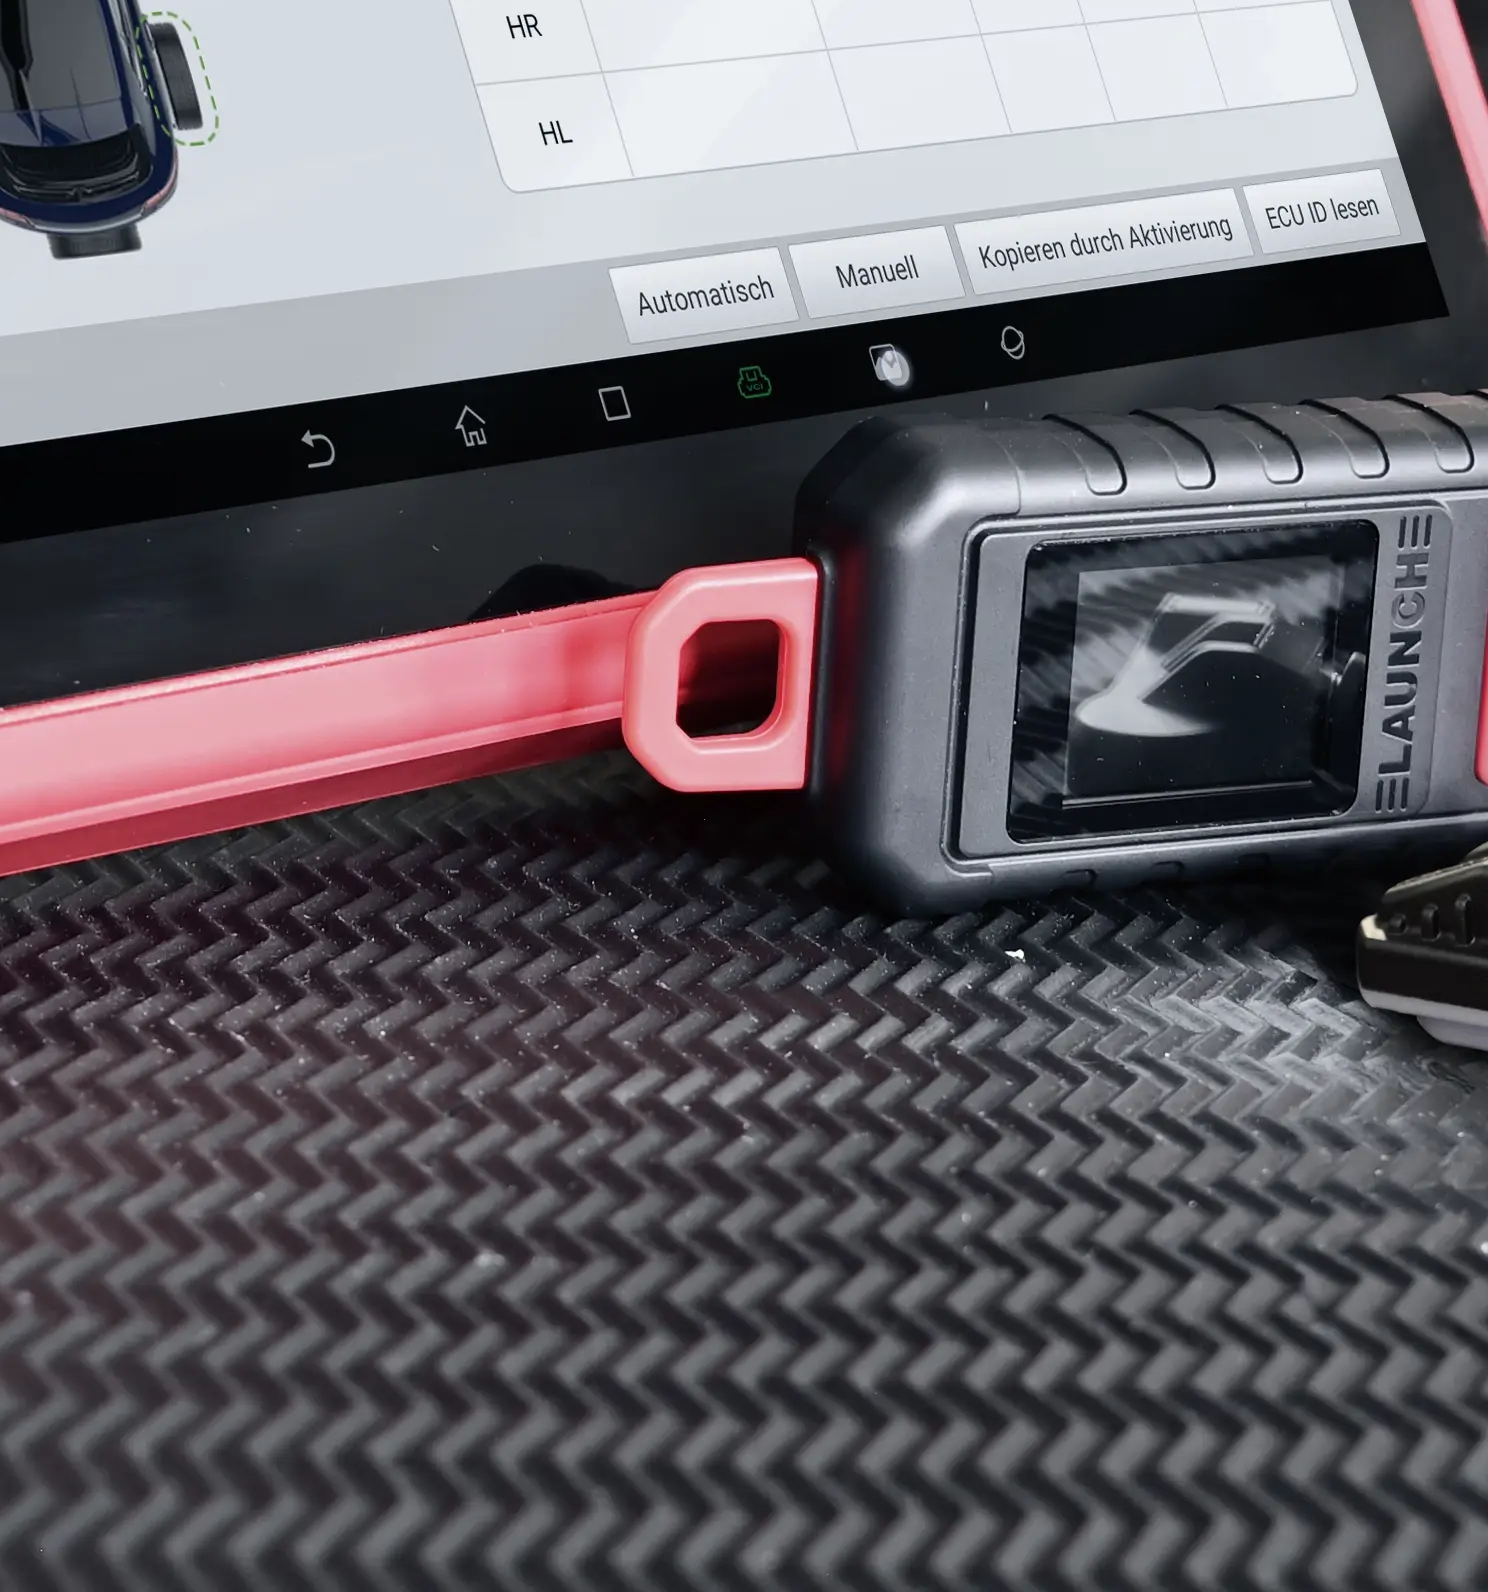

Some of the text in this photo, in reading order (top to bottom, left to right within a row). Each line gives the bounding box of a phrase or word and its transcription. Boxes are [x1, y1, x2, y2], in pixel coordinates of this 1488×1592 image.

[506, 14, 542, 39] HR
[539, 121, 573, 145] HL
[1265, 199, 1379, 229] ECU ID lesen
[979, 219, 1232, 271] Kopieren durch Aktivierung
[836, 255, 919, 288] Manuell
[640, 275, 774, 316] Automatisch
[1378, 552, 1430, 776] LAUNCH
